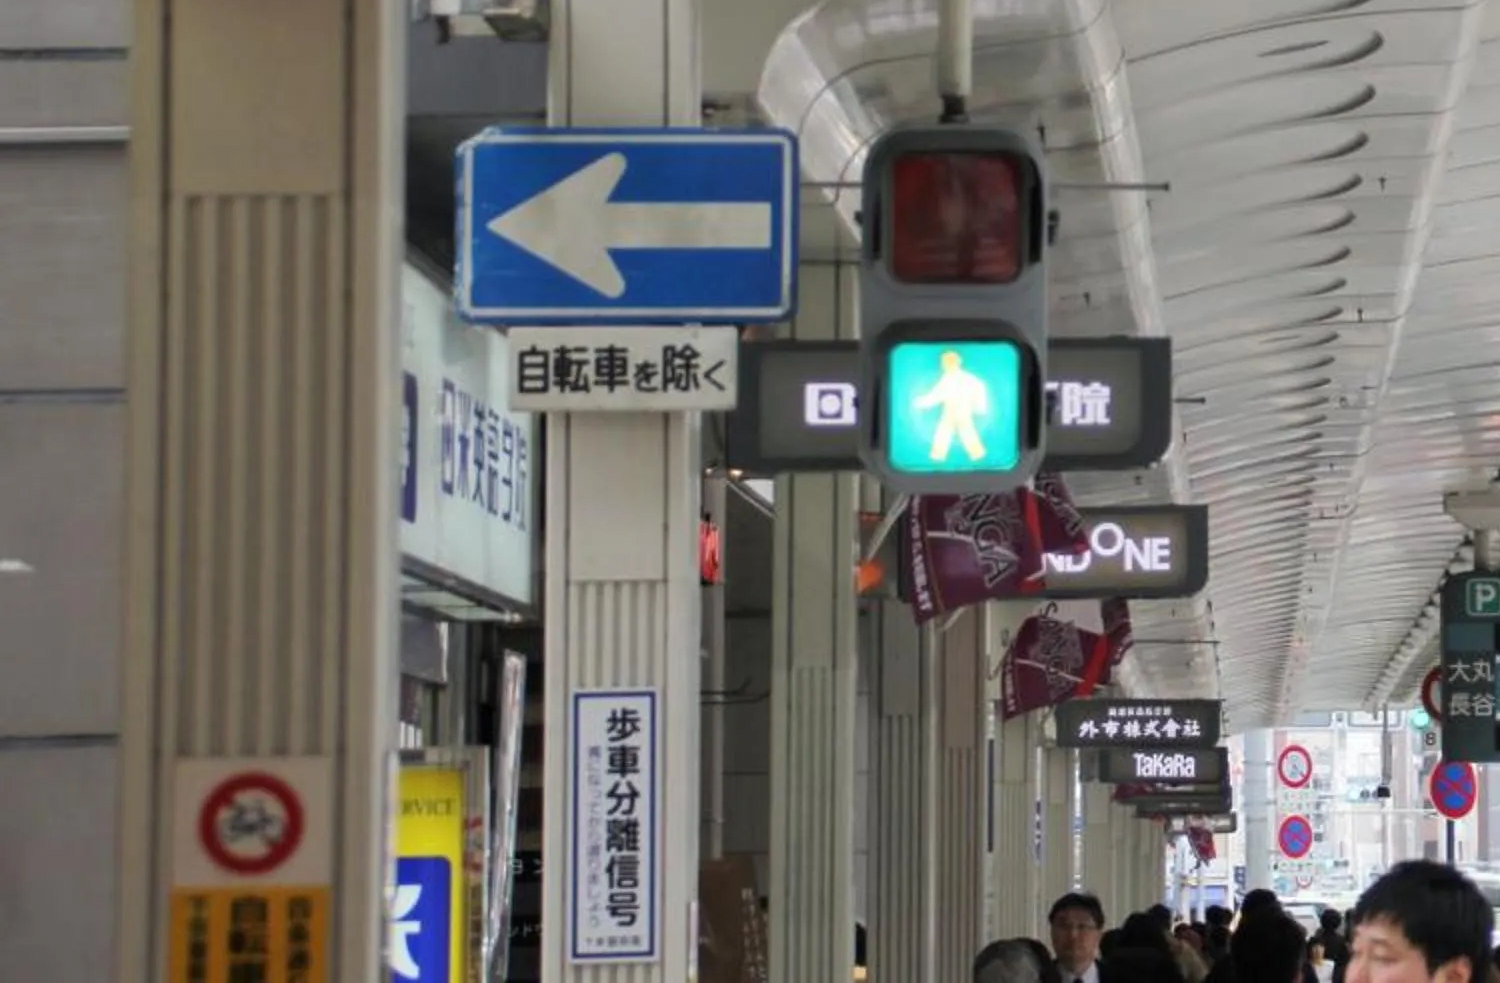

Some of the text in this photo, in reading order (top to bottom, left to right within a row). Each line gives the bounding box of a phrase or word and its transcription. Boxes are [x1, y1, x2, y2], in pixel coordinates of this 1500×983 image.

[518, 344, 726, 394] 自転車を除く
[1448, 658, 1495, 683] 大丸
[1448, 692, 1496, 717] 長谷
[605, 706, 641, 927] 歩車分離信号
